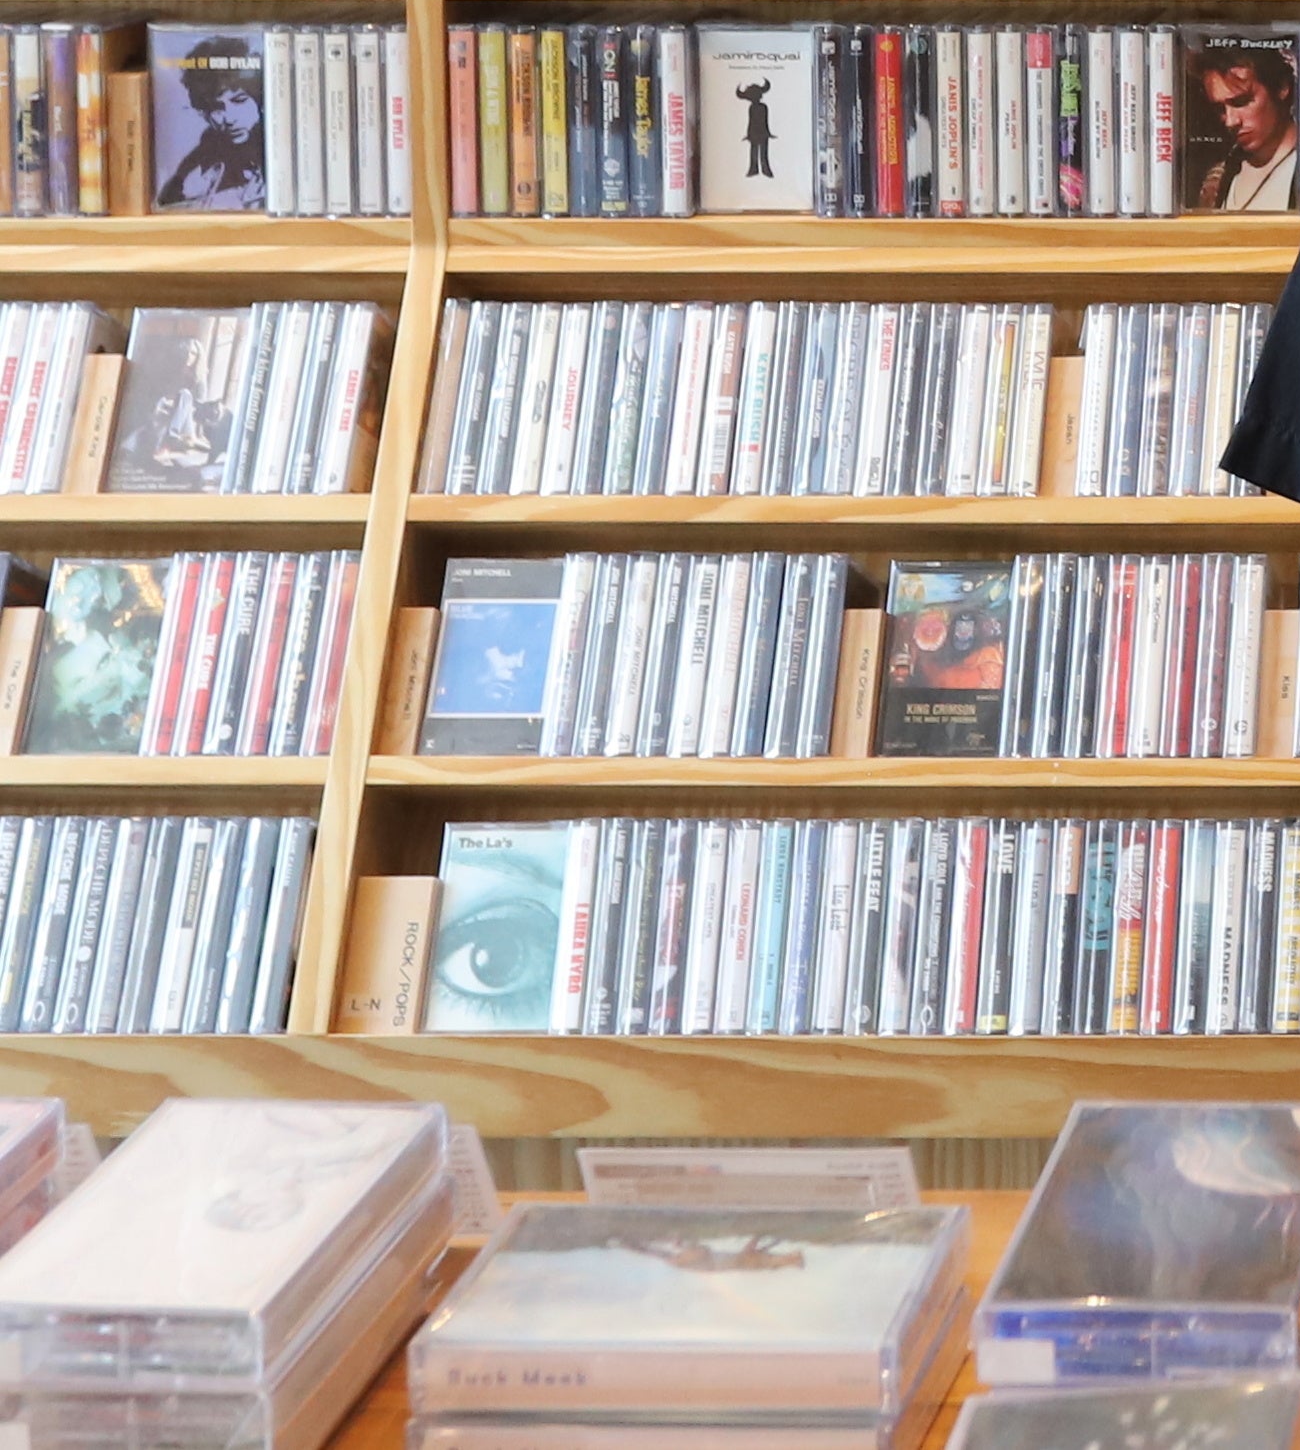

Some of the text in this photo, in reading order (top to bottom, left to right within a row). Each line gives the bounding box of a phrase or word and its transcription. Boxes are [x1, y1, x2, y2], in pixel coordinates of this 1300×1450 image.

[1206, 39, 1292, 49] JEFF BUCKLEY
[668, 92, 684, 190] JAMES TAYLOR
[947, 76, 959, 170] JANIS JOPLIN'S
[1156, 92, 1172, 163] JEFF BECK
[879, 318, 894, 370] THE KINKS
[691, 571, 715, 665] JONI MITCHELL
[906, 704, 976, 715] KING CRIMSON
[1282, 676, 1290, 699] Kiss
[459, 838, 485, 848] The
[998, 833, 1015, 874] LOVE
[1257, 832, 1273, 892] MADNESS
[393, 922, 420, 1027] ROCK/POPS
